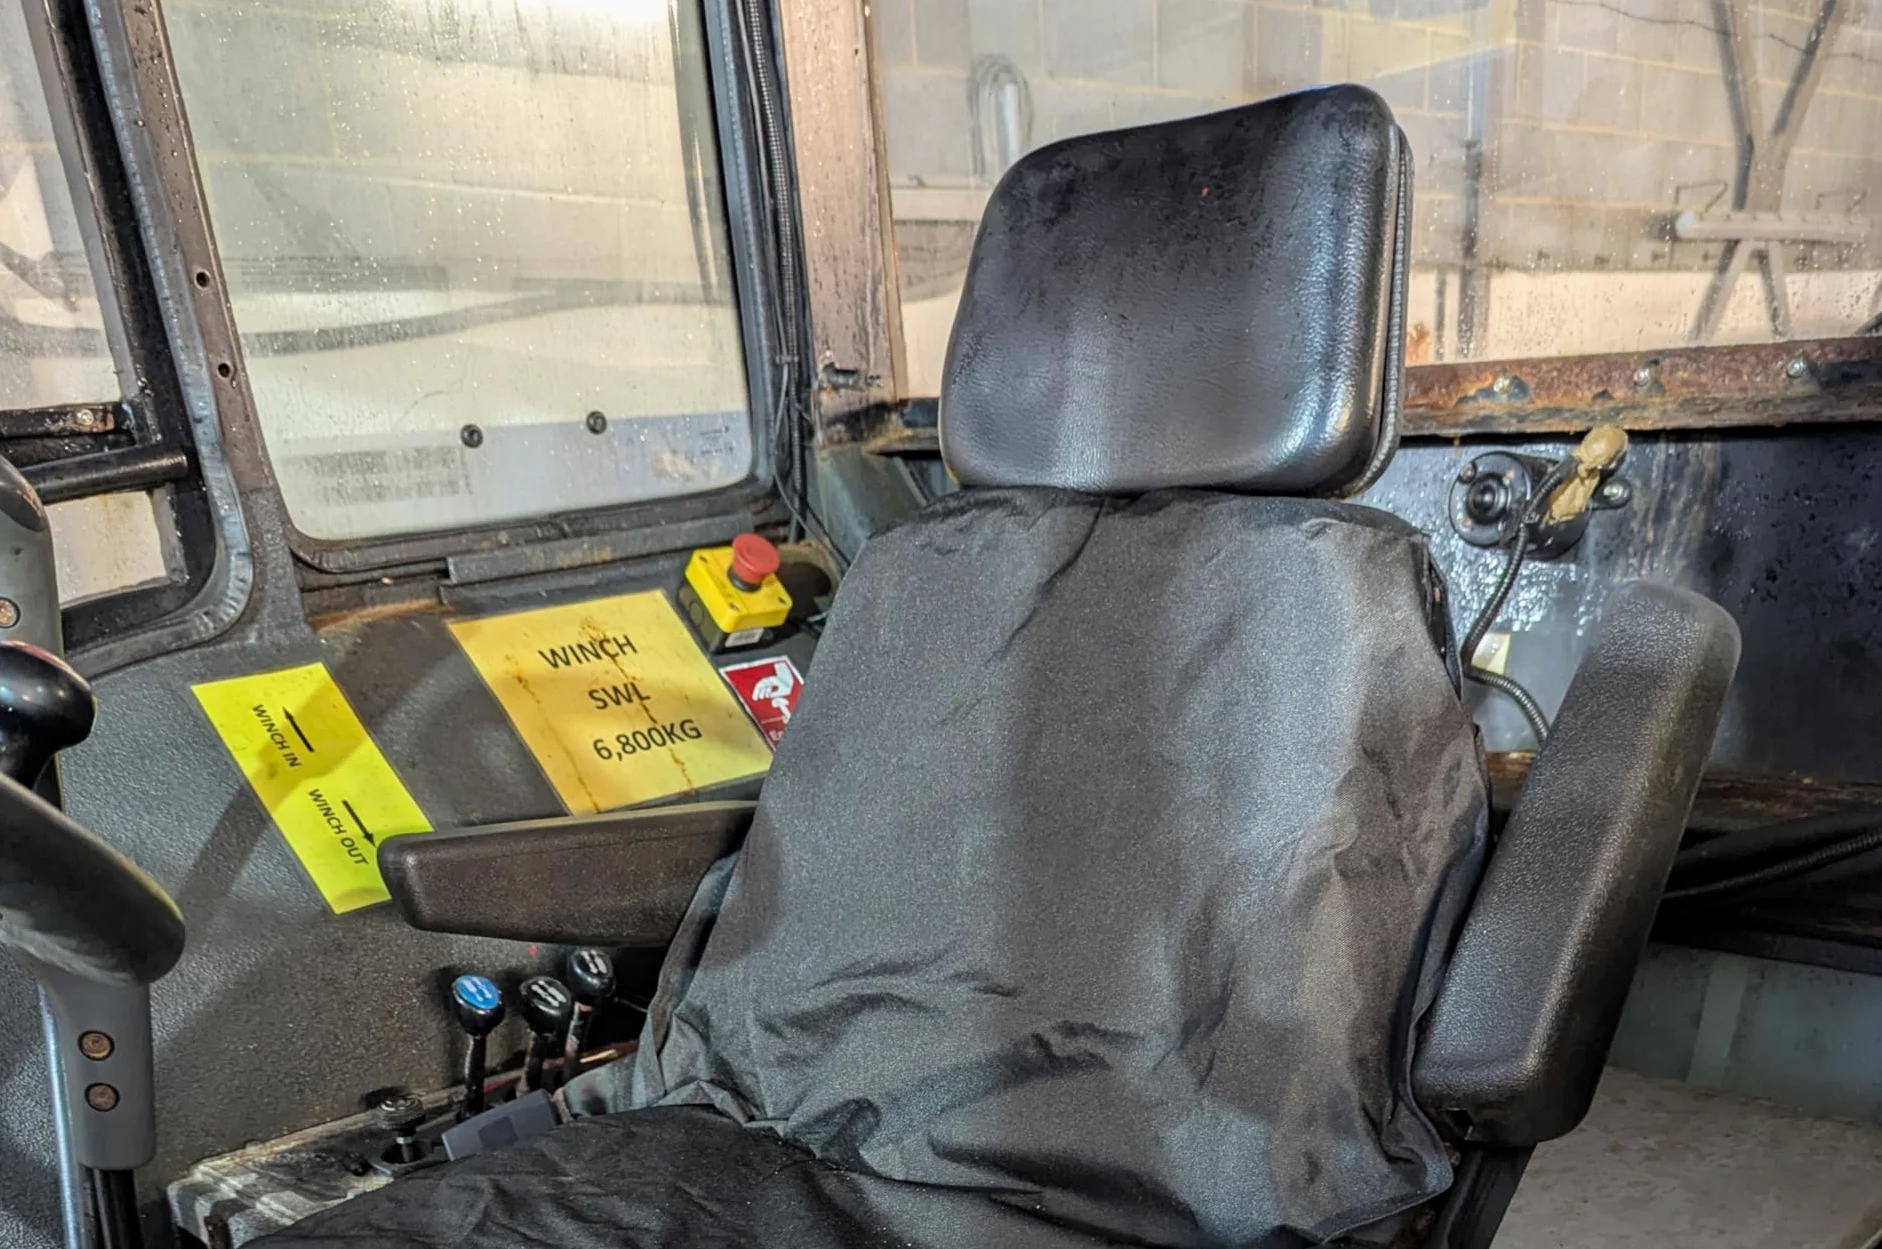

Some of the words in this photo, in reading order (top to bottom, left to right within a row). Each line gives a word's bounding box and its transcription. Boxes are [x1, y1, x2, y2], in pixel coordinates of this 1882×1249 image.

[538, 634, 638, 669] WINCH
[588, 681, 652, 710] SWL
[252, 704, 290, 751] WINCH
[283, 752, 302, 767] IN
[593, 718, 703, 762] 6,800KG
[308, 788, 346, 836] WINCH
[340, 837, 369, 866] OUT
